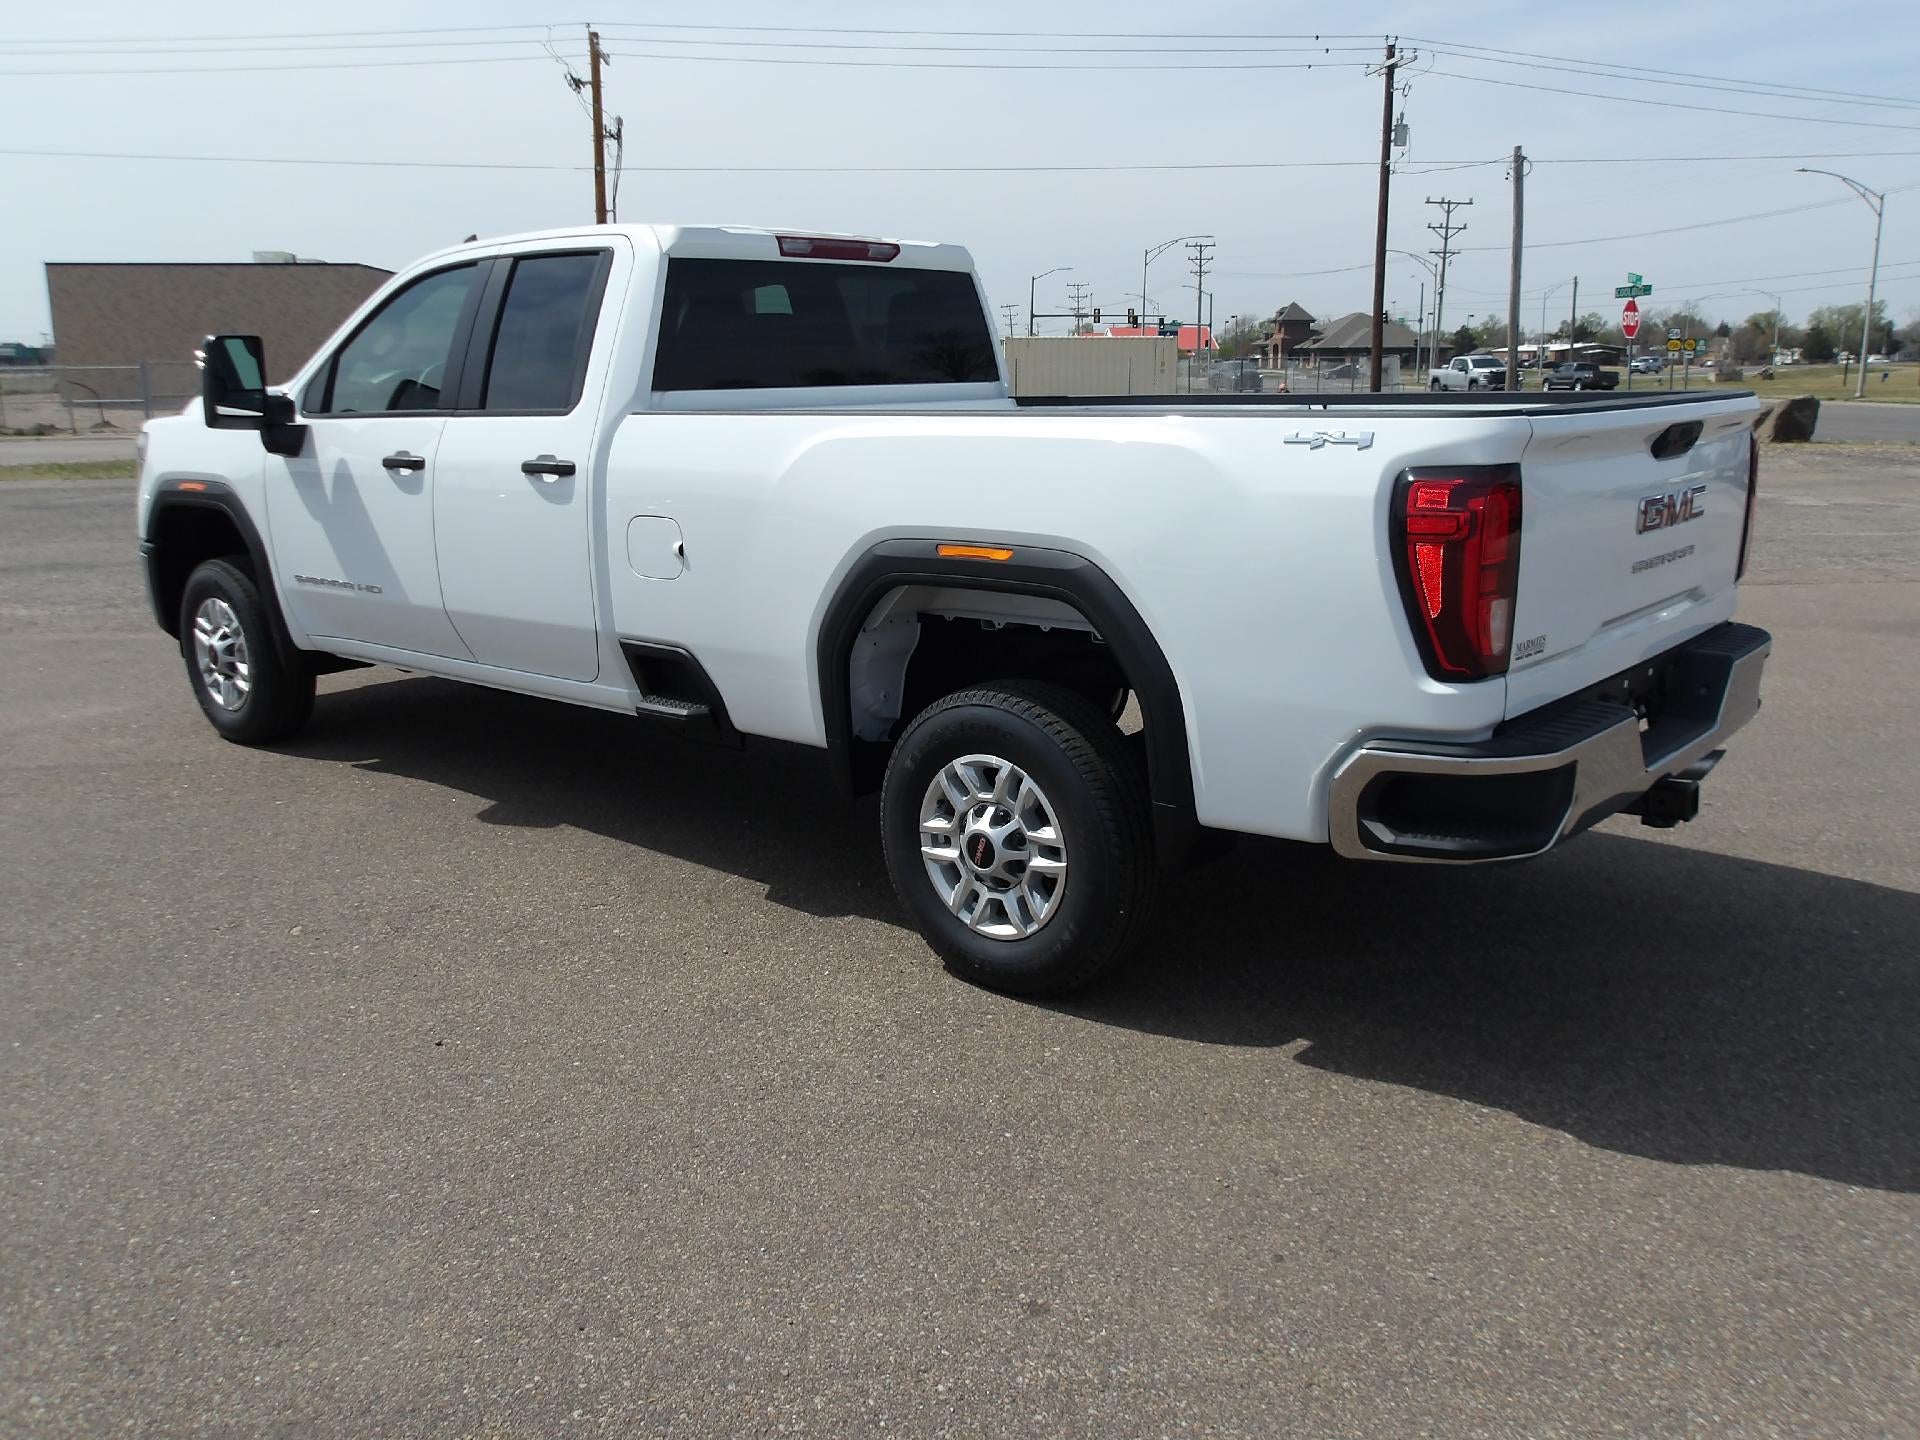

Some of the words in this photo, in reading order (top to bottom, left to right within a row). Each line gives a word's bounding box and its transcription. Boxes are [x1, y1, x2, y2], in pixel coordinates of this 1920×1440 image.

[1623, 312, 1638, 326] STOP
[1636, 483, 1707, 535] GMC
[358, 583, 383, 594] HD
